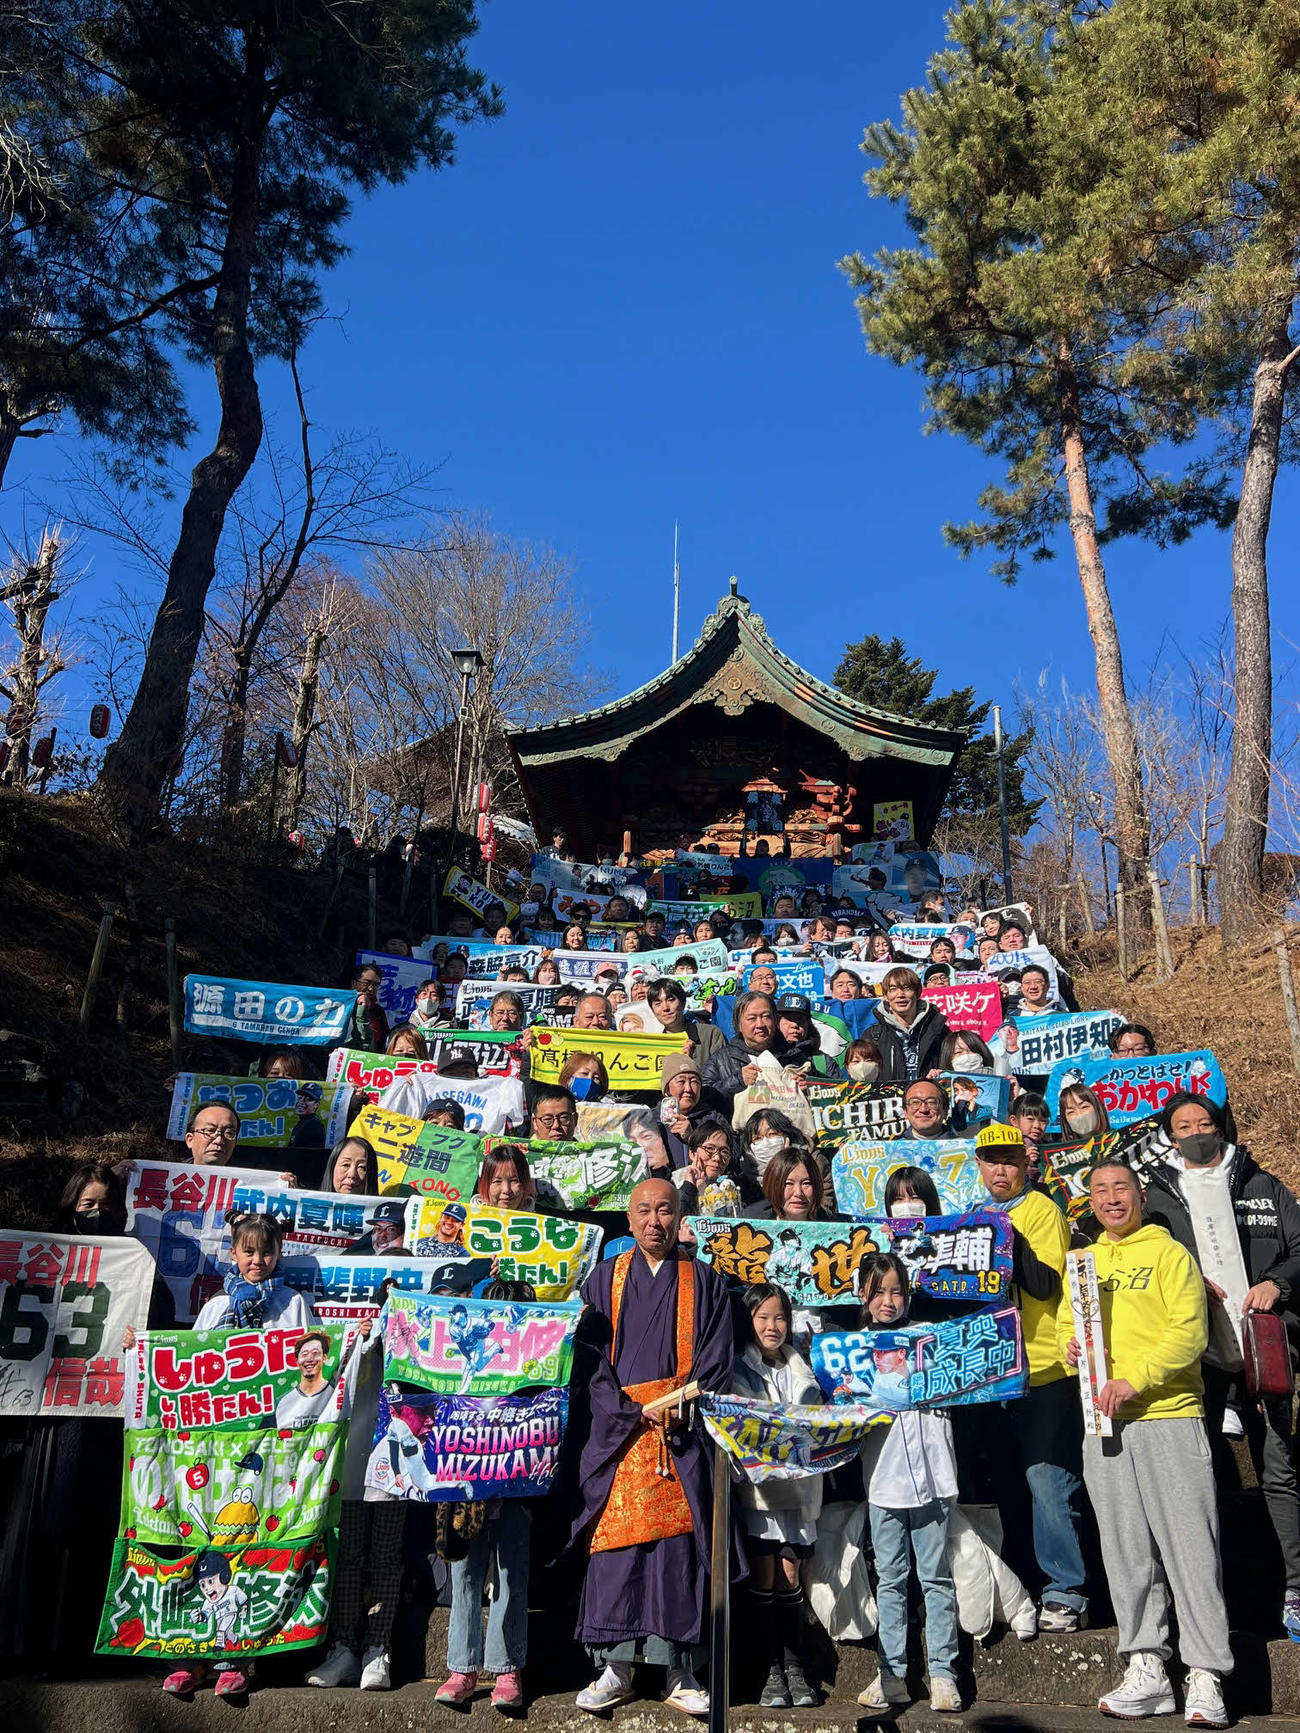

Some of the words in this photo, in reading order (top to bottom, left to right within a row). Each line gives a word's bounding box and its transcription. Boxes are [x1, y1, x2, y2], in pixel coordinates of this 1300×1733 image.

[474, 885, 499, 905] YUT
[192, 982, 345, 1026] 源田の力
[365, 1112, 417, 1136] キャプ
[811, 1096, 905, 1131] ICHIR
[432, 1133, 466, 1149] フク
[978, 1131, 1021, 1146] HB-101
[133, 1168, 239, 1213] 長谷川
[696, 1219, 731, 1234] Lions
[0, 1240, 102, 1289] 長谷川
[977, 1270, 1001, 1294] 19
[0, 1280, 112, 1361] 63
[152, 1328, 306, 1392] しゅうた
[819, 1333, 875, 1373] 62
[927, 1339, 1015, 1400] 成長中
[43, 1357, 125, 1407] 信哉
[134, 1381, 145, 1420] SHUTA
[432, 1416, 560, 1453] YOSHINOBU
[192, 1470, 204, 1486] 5
